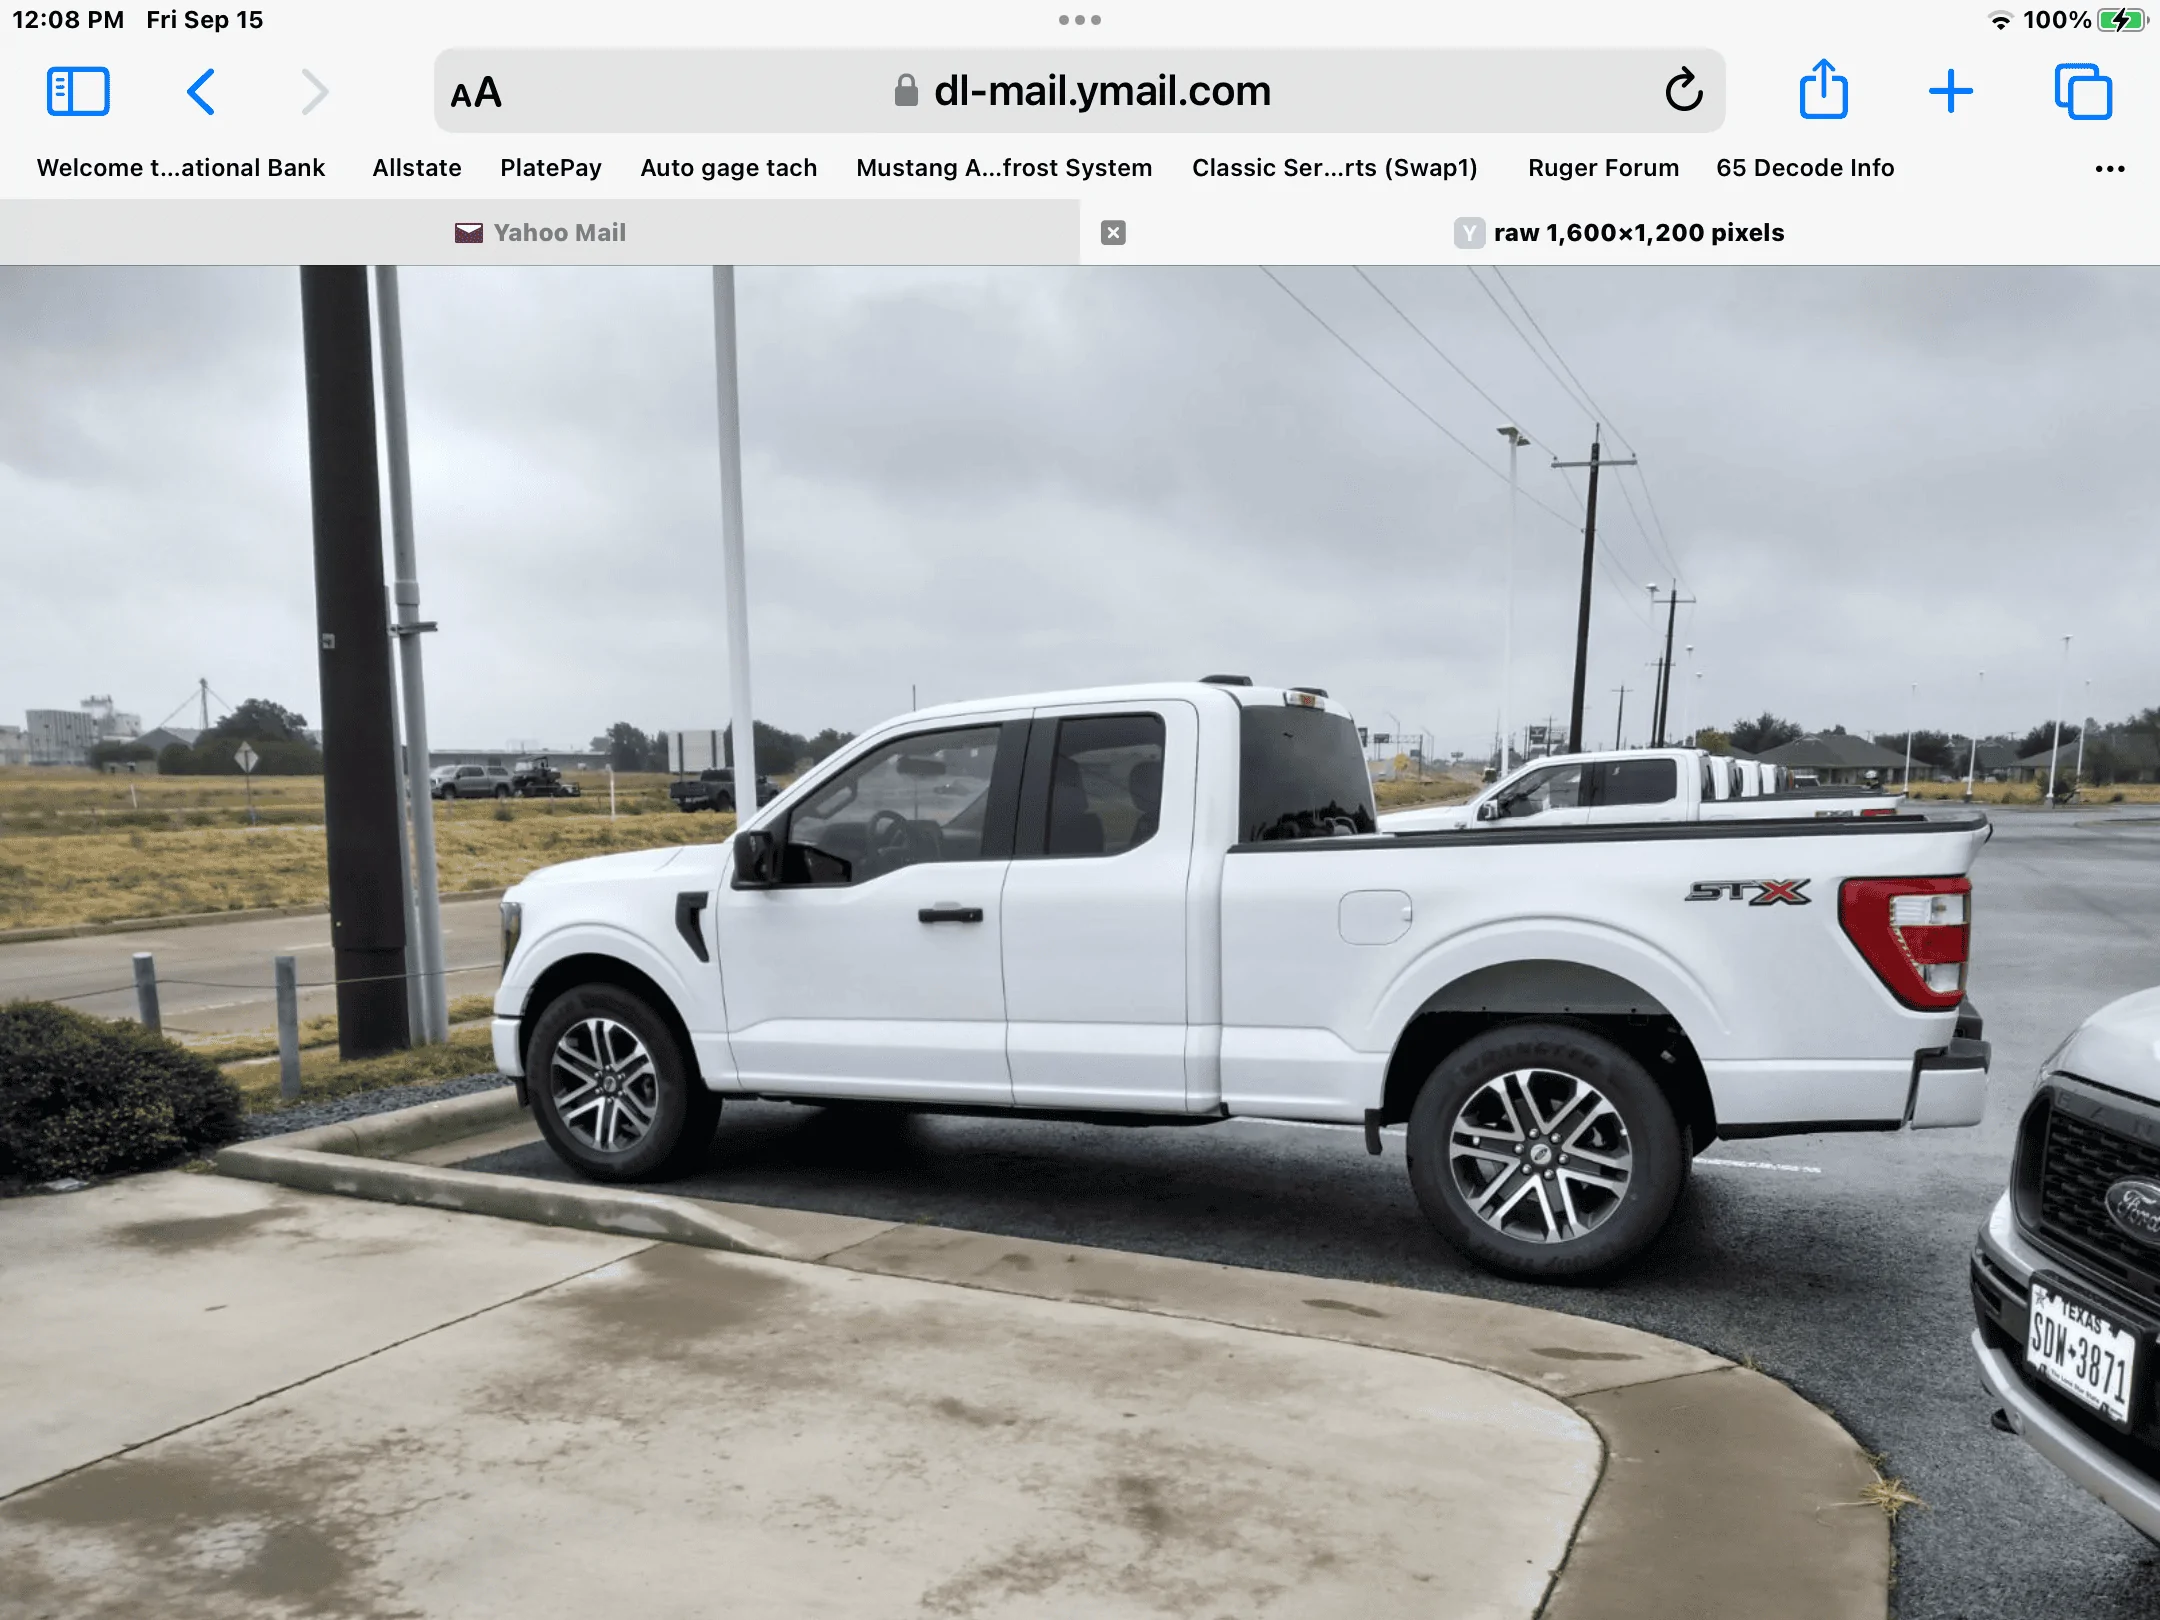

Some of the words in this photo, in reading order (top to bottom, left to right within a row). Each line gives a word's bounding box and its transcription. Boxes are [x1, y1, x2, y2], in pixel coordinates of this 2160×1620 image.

[13, 10, 79, 29] 12:08
[89, 10, 124, 29] PM
[148, 9, 177, 29] Fri
[185, 10, 230, 34] Sep
[237, 10, 264, 29] 15
[2024, 9, 2093, 30] 100%
[935, 73, 1271, 114] dl-mail.ymail.com
[37, 158, 143, 177] Welcome
[268, 157, 326, 177] Bank
[373, 157, 462, 177] Allstate
[501, 157, 603, 182] PlatePay
[641, 158, 695, 177] Auto
[702, 162, 760, 182] gage
[766, 157, 817, 177] tach
[857, 158, 958, 182] Mustang
[1065, 157, 1152, 182] System
[1192, 157, 1276, 177] Classic
[1385, 157, 1477, 182] (Swap1)
[1529, 158, 1599, 182] Ruger
[1606, 158, 1679, 177] Forum
[1716, 157, 1747, 177] 65
[1754, 157, 1844, 177] Decode
[1851, 157, 1895, 177] Info
[494, 223, 569, 242] Yahoo
[577, 222, 626, 242] Mail
[1463, 225, 1477, 242] Y
[1494, 226, 1541, 242] raw
[1712, 221, 1785, 247] pixels
[1684, 878, 1813, 906] STX
[2061, 1300, 2102, 1334] TEXAS
